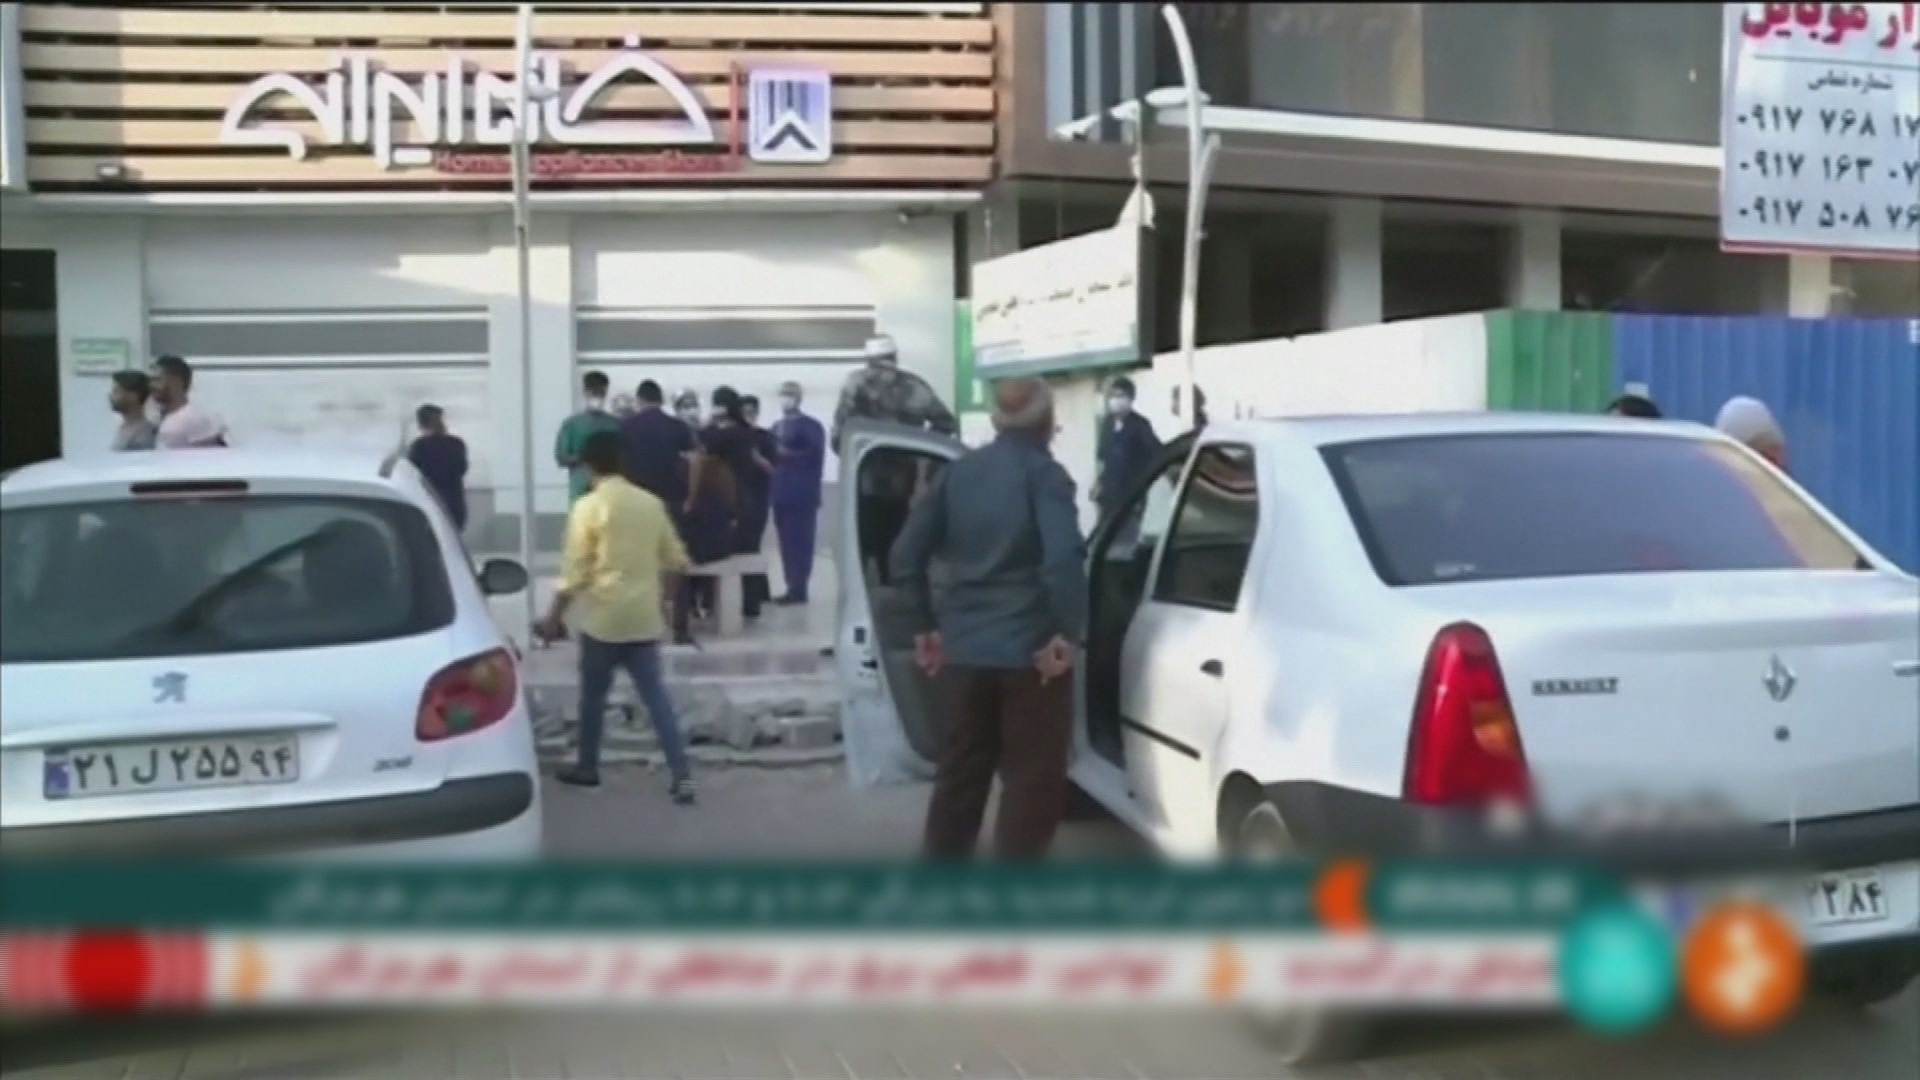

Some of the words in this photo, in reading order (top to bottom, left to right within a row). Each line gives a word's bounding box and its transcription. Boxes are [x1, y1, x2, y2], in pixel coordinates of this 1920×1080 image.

[1738, 103, 1804, 132] ۰۹۱۷
[1820, 108, 1876, 137] ۷۶۸
[1739, 150, 1804, 178] ۰۹۱۷
[1823, 154, 1873, 182] ۱۶۳
[1739, 196, 1804, 225] ۰۹۱۷
[1818, 202, 1871, 228] ۵۰۸
